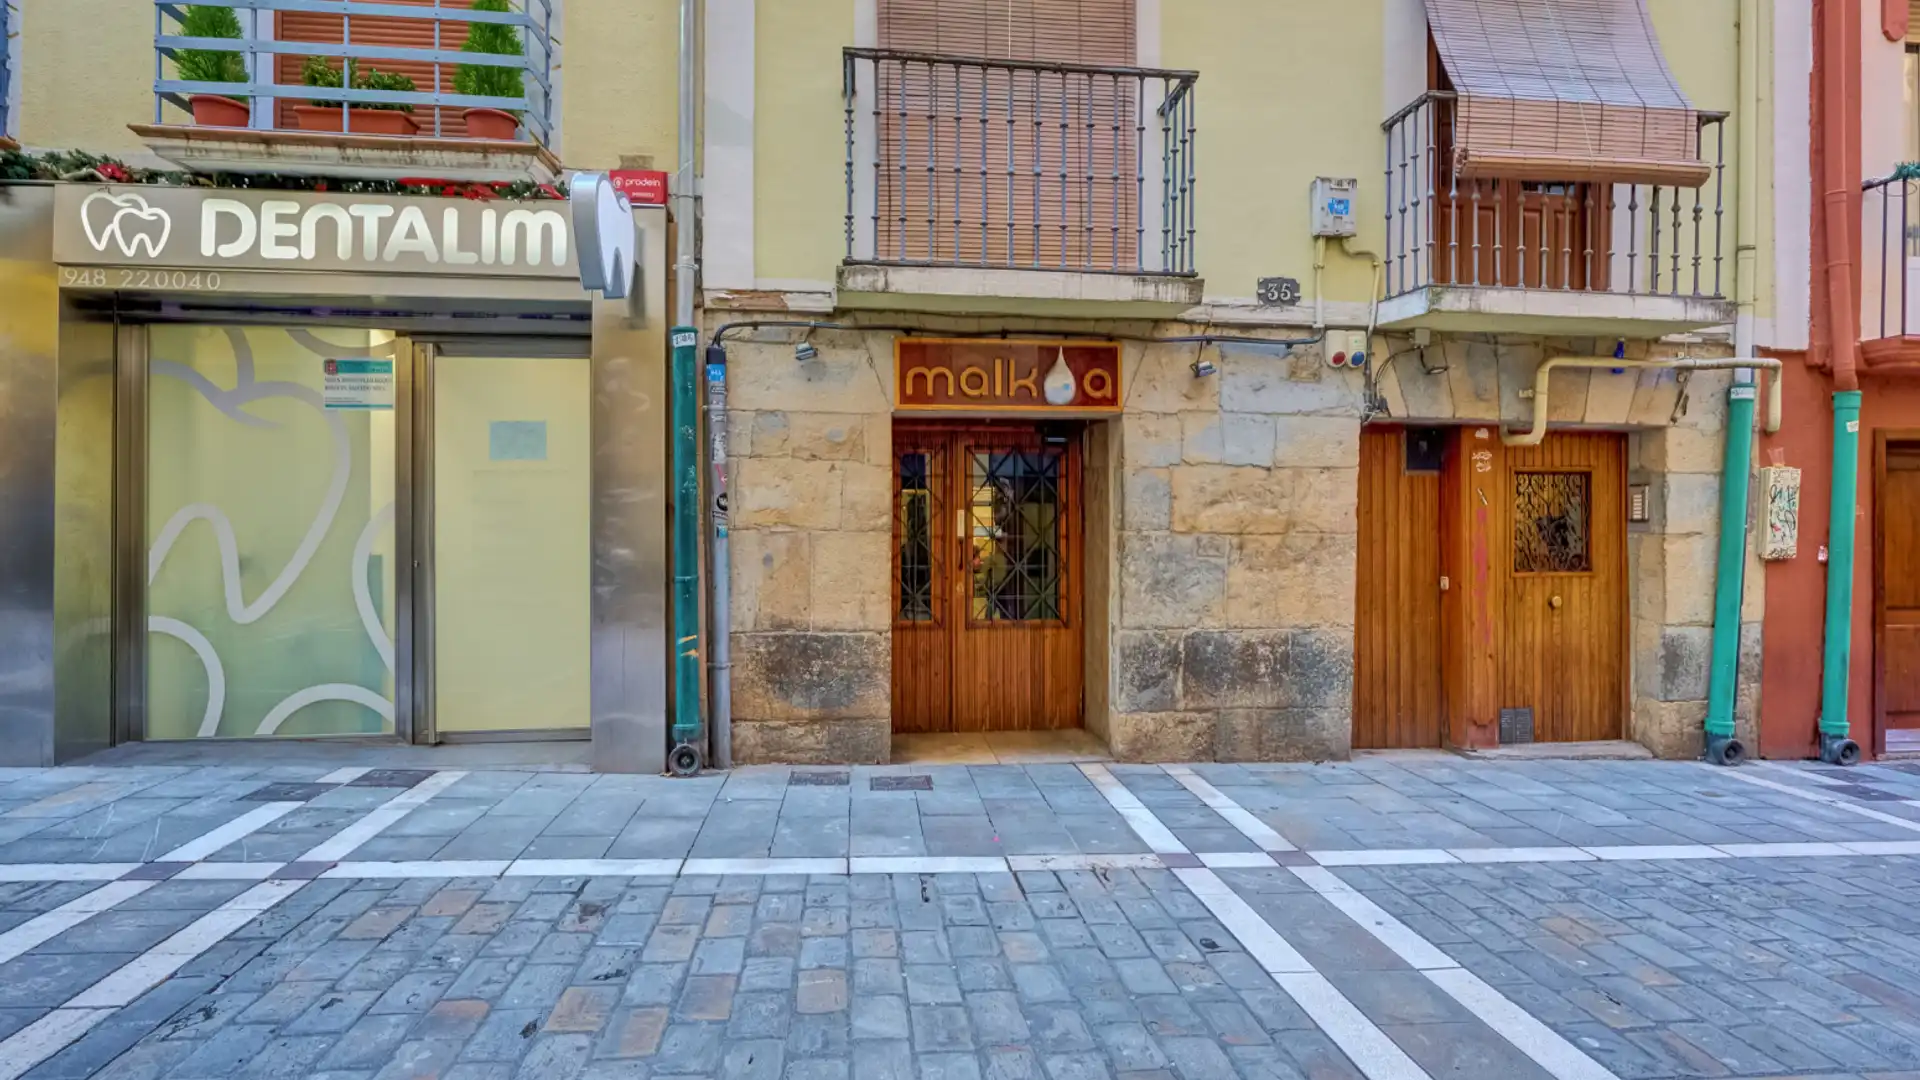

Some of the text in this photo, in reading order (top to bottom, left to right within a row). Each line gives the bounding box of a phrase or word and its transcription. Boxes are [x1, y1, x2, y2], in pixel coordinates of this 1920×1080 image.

[64, 269, 222, 291] 948 220040
[1267, 282, 1291, 301] 35
